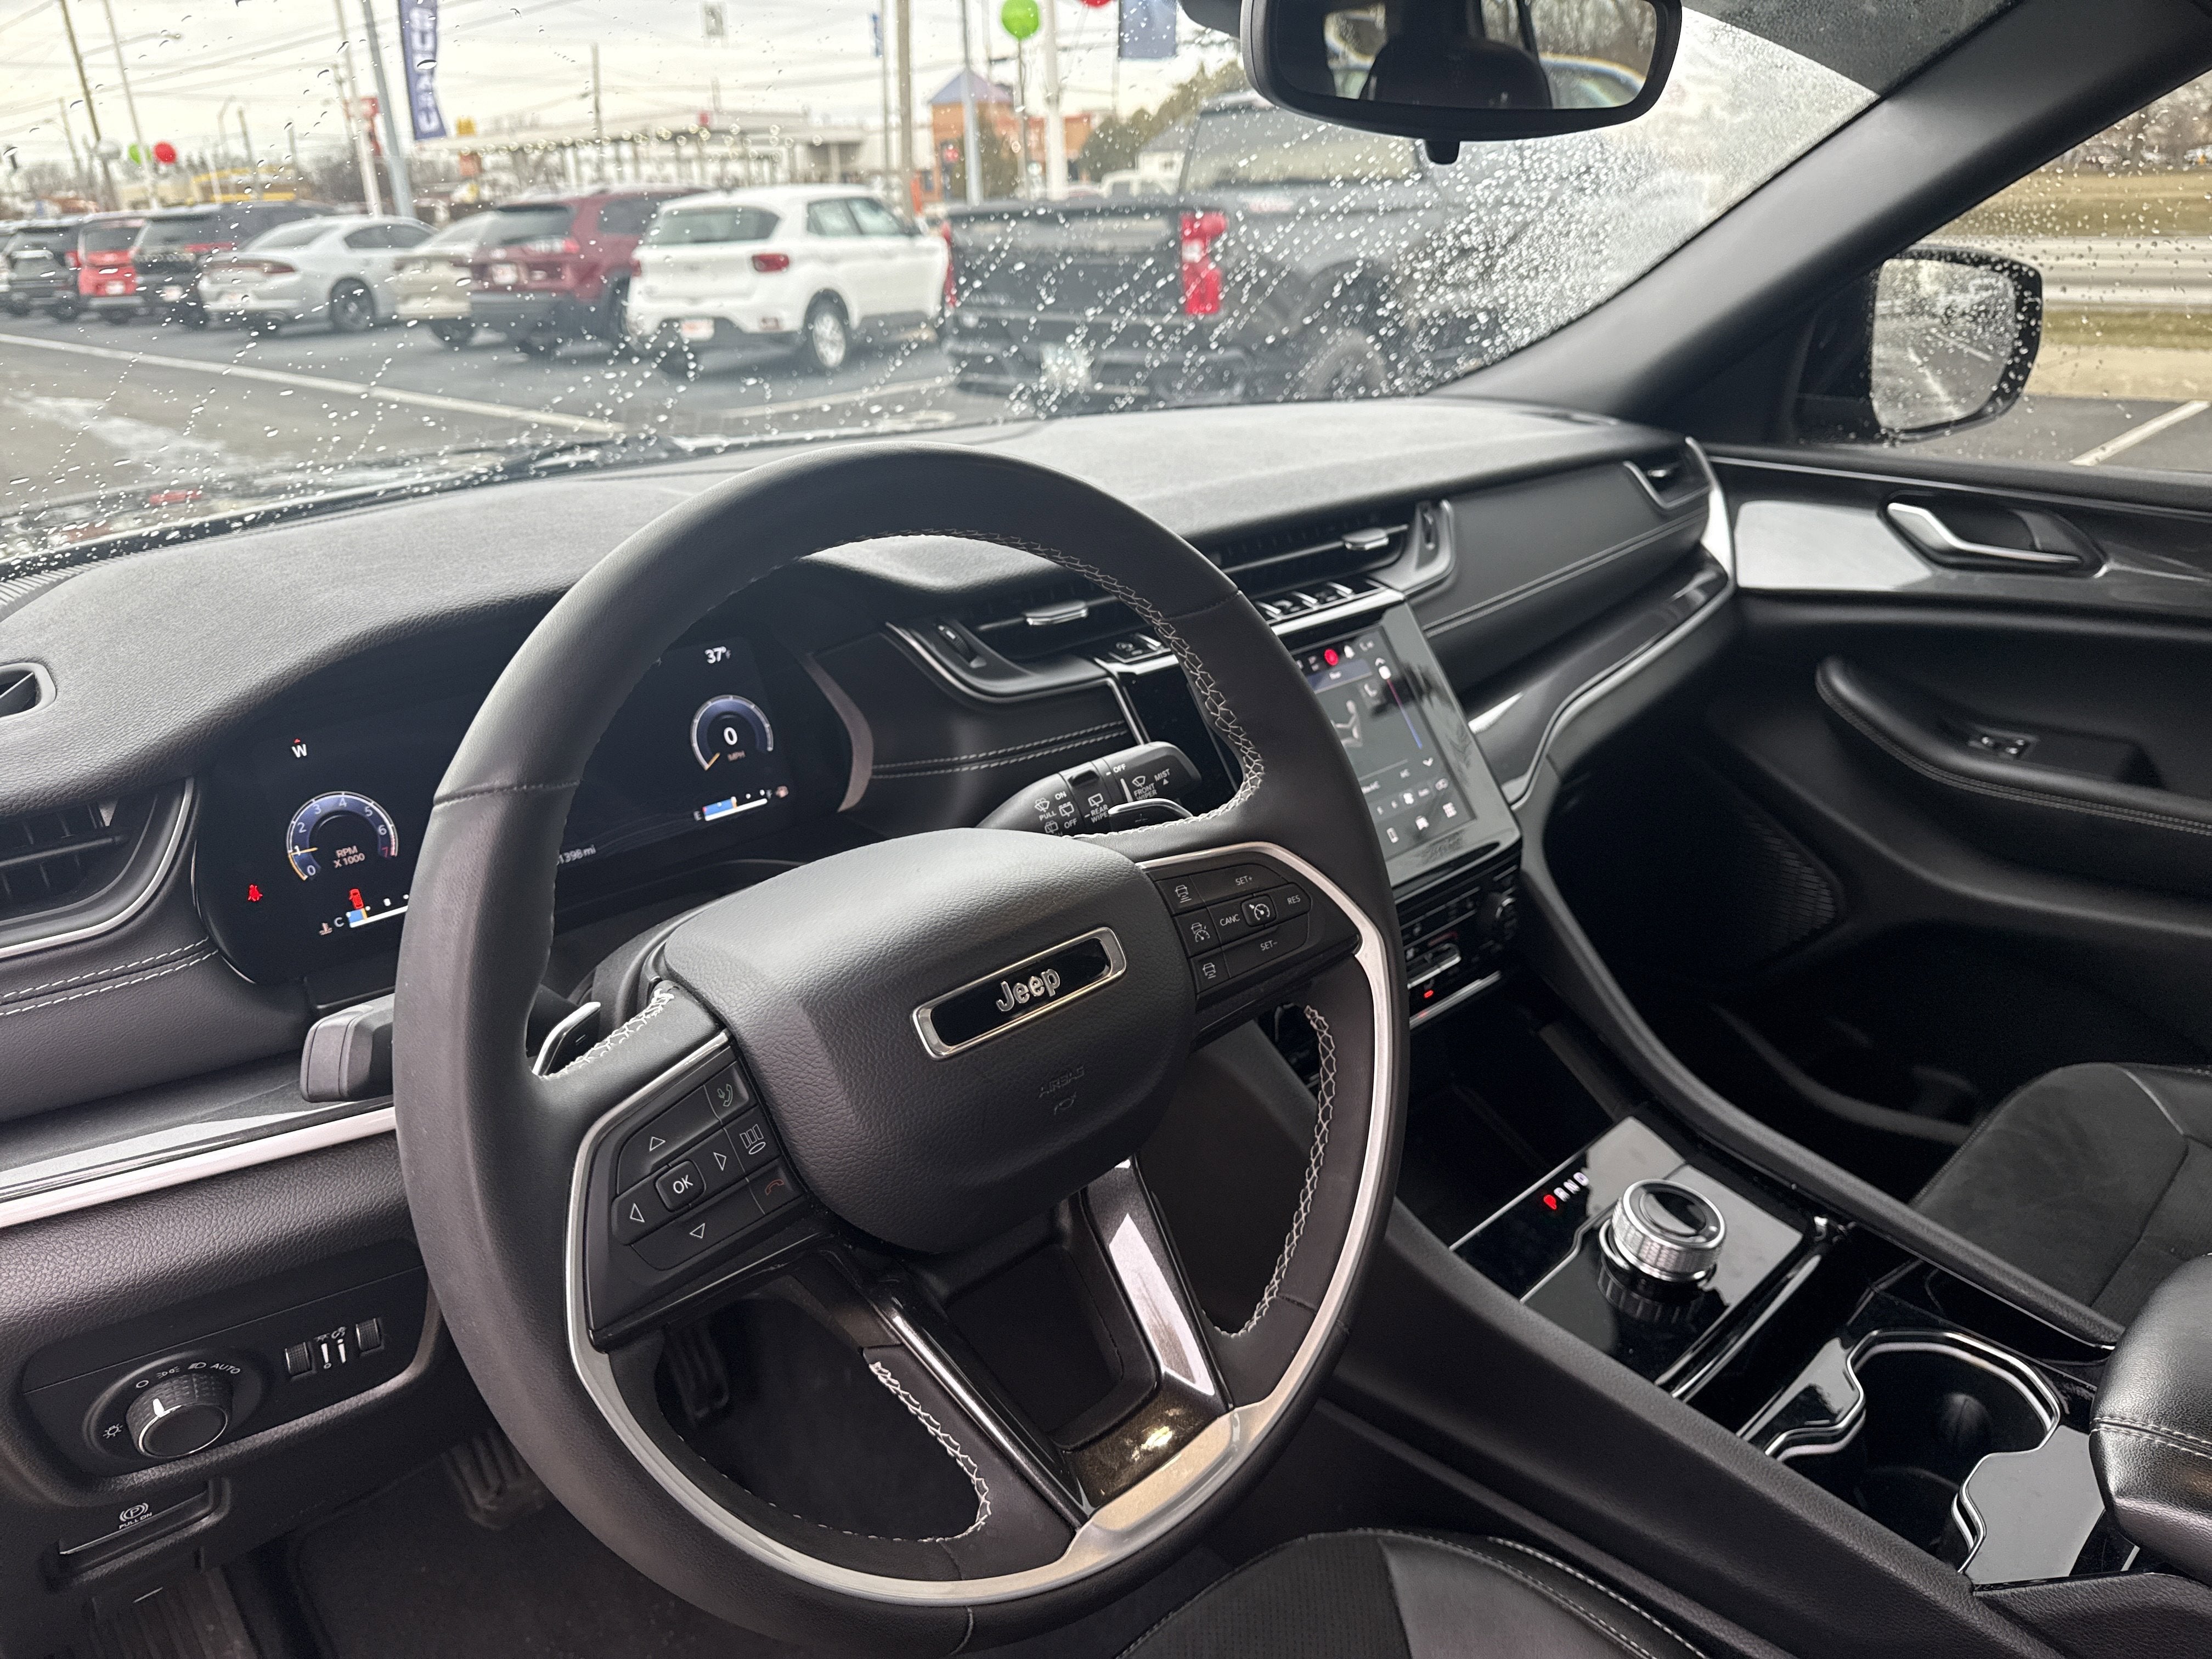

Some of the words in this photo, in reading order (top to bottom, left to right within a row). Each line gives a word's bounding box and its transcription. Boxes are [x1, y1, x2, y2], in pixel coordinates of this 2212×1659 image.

[724, 727, 737, 745] 0
[292, 743, 307, 758] W
[727, 750, 746, 761] MPH
[1113, 763, 1126, 773] OFF
[1154, 769, 1170, 782] MIST
[1133, 782, 1155, 797] FRONT
[1136, 789, 1158, 800] WIPER
[1054, 791, 1067, 800] ON
[339, 797, 347, 808] 4
[313, 804, 321, 815] 3
[364, 806, 373, 817] 5
[1090, 804, 1108, 816] REAR
[693, 810, 702, 821] E
[1039, 810, 1057, 821] PULL
[1090, 812, 1111, 823] WIPE
[297, 821, 307, 833] 2
[1064, 817, 1077, 828] OFF
[378, 824, 387, 836] 6
[294, 845, 301, 856] 1
[336, 845, 358, 858] RPM
[381, 847, 388, 858] 7
[333, 860, 342, 869] X
[343, 853, 365, 866] 1000
[307, 865, 316, 876] 0
[1235, 876, 1253, 885] SET+
[1286, 895, 1301, 905] RES
[334, 917, 345, 927] C
[1220, 914, 1240, 926] CANC
[996, 968, 1060, 1012] Jeep
[1039, 1065, 1085, 1098] AIRBAG
[673, 1175, 693, 1194] OK
[210, 1363, 241, 1374] AUTO
[119, 1519, 139, 1530] PULL
[140, 1512, 153, 1520] ON
